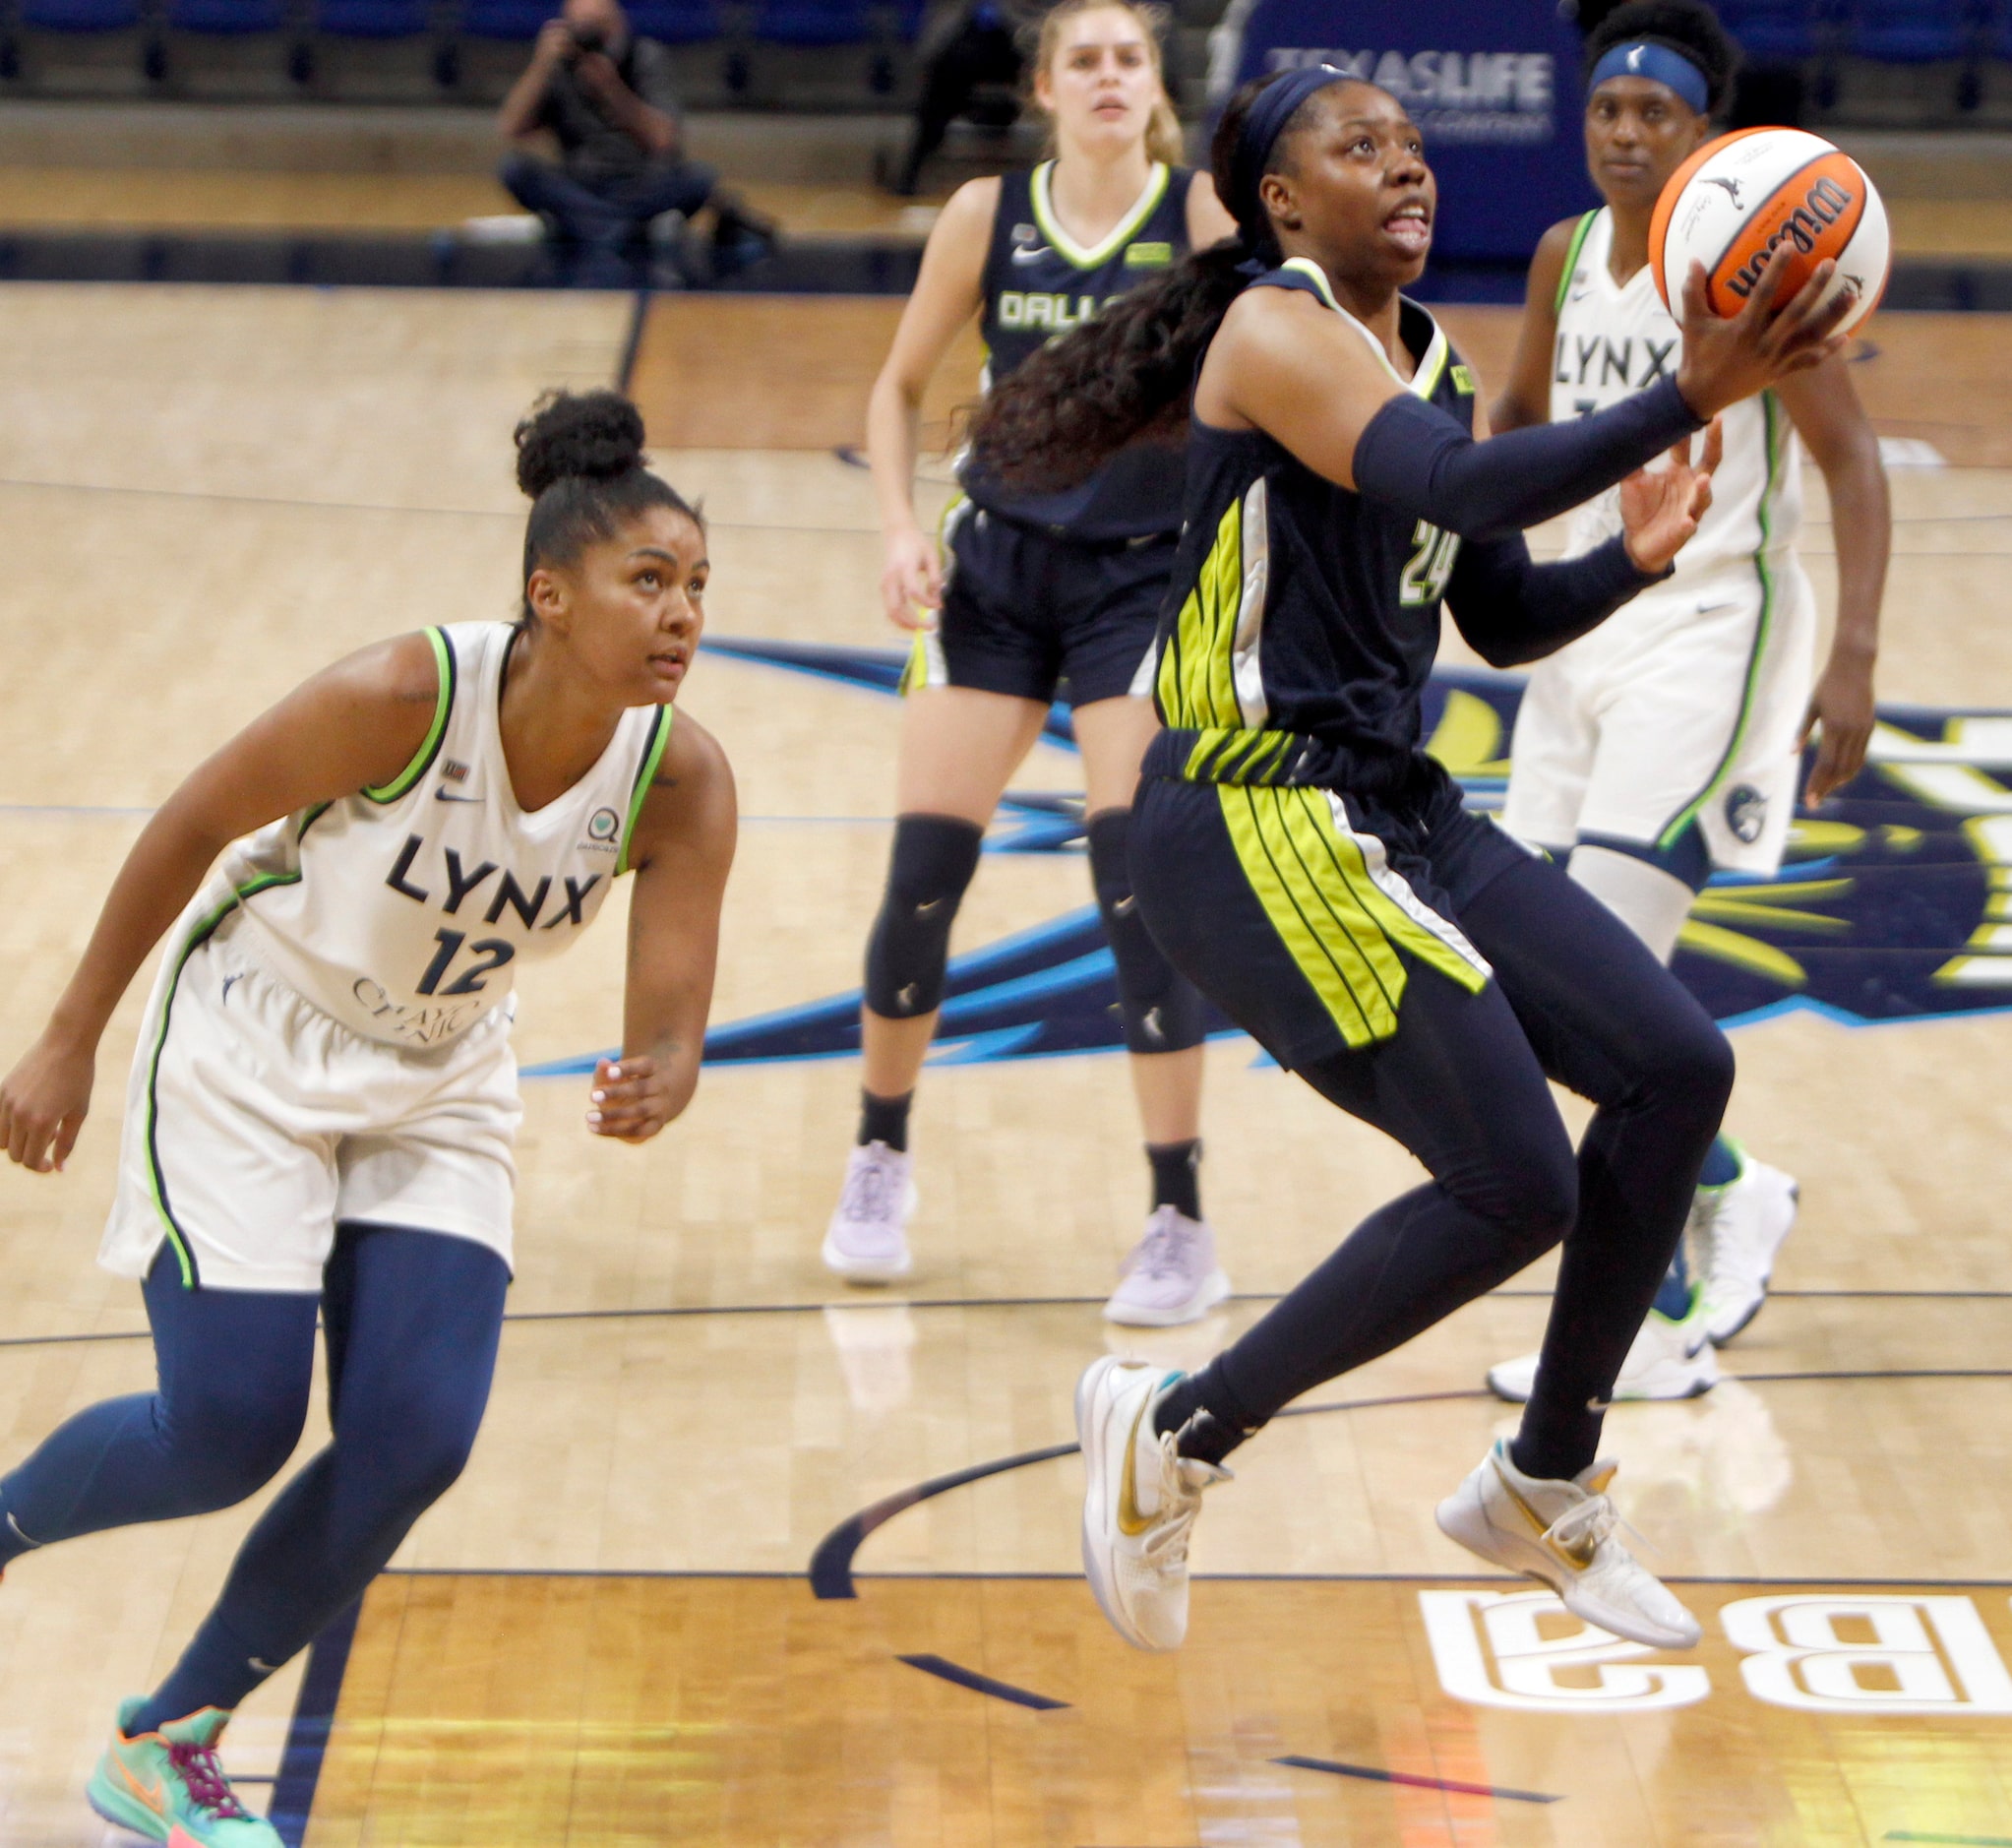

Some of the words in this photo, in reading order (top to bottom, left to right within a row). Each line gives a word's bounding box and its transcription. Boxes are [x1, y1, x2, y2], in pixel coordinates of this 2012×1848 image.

[1555, 333, 1678, 388] LYNX
[1399, 518, 1462, 607] 24
[385, 832, 604, 931] LYNX
[414, 926, 517, 997] 12
